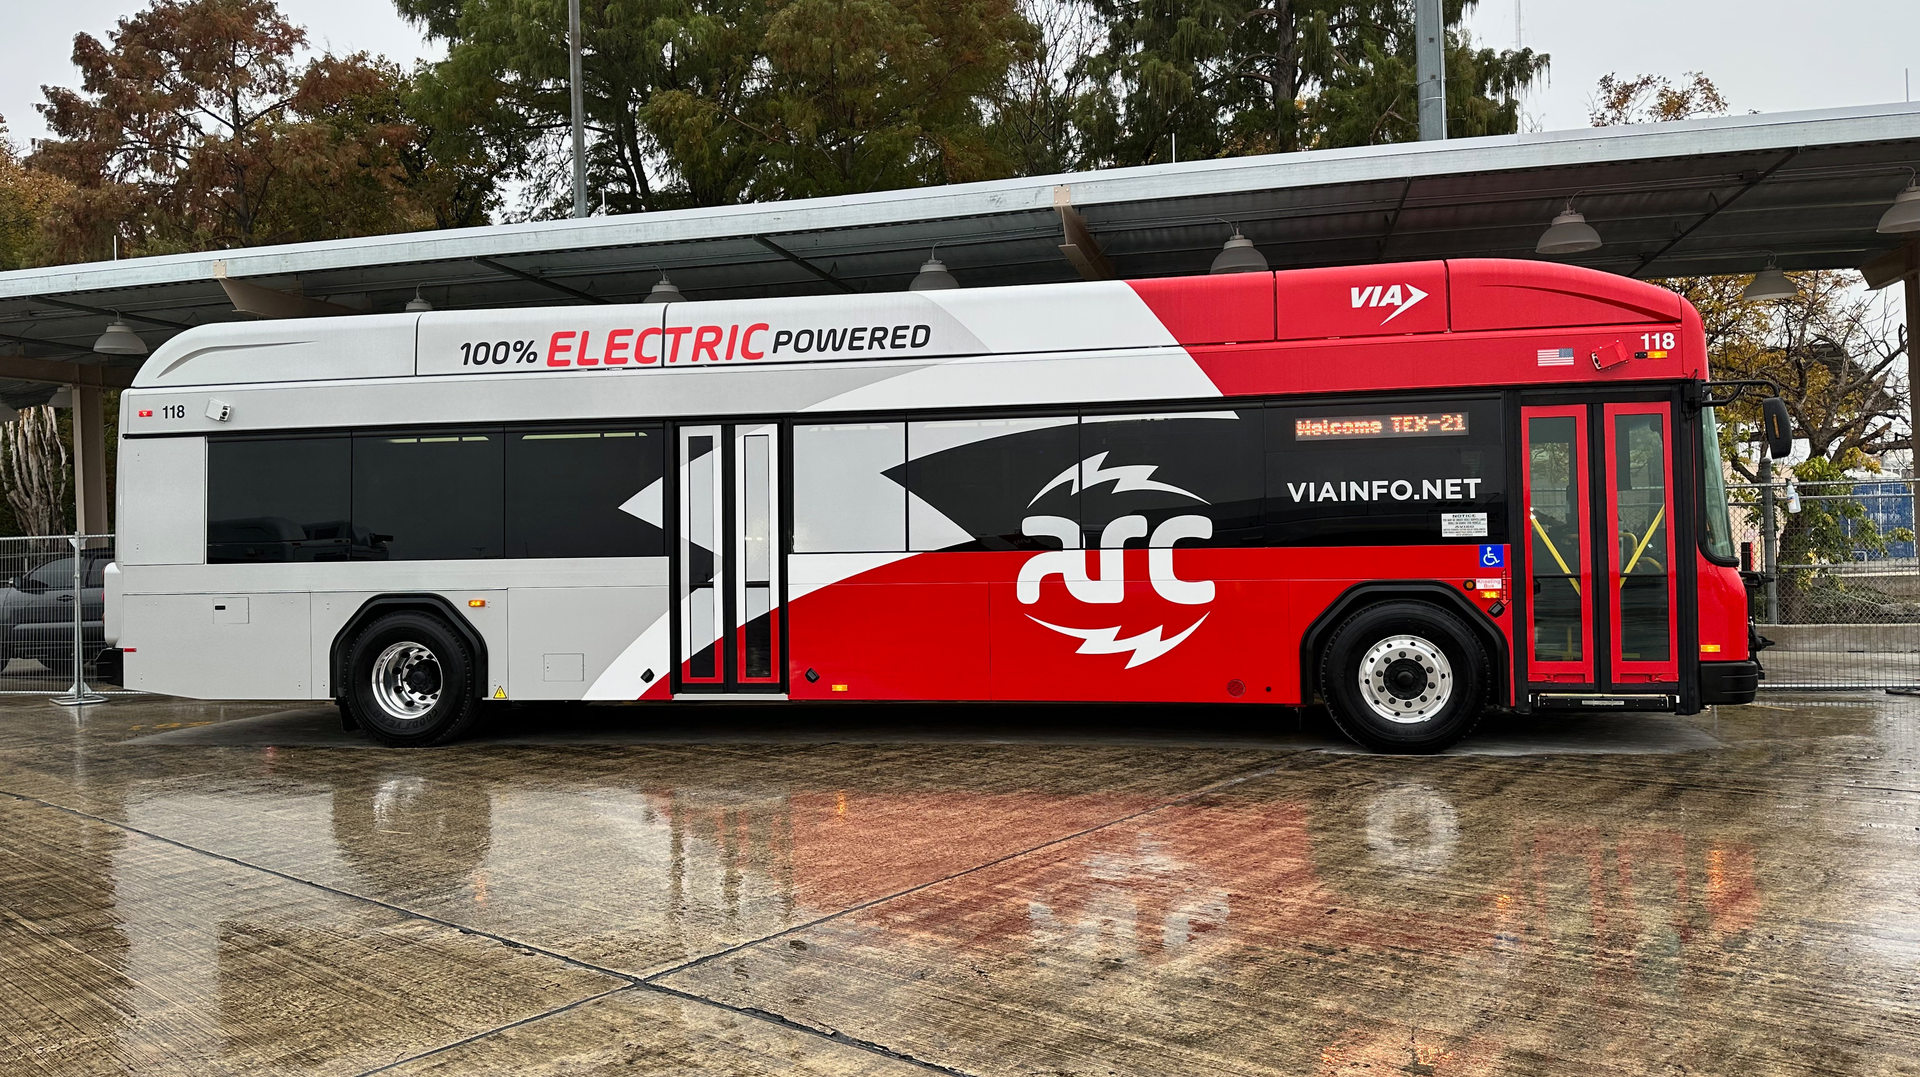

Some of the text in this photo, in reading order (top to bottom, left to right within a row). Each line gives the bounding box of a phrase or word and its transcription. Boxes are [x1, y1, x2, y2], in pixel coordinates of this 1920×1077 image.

[1351, 284, 1402, 308] VIA
[460, 323, 931, 367] 100% ELECTRIC POWERED
[1640, 333, 1675, 349] 118
[162, 405, 186, 419] 118
[1296, 413, 1466, 436] Welcome TEX-21
[1286, 478, 1482, 503] VIAINFO.NET
[1017, 514, 1216, 605] arc
